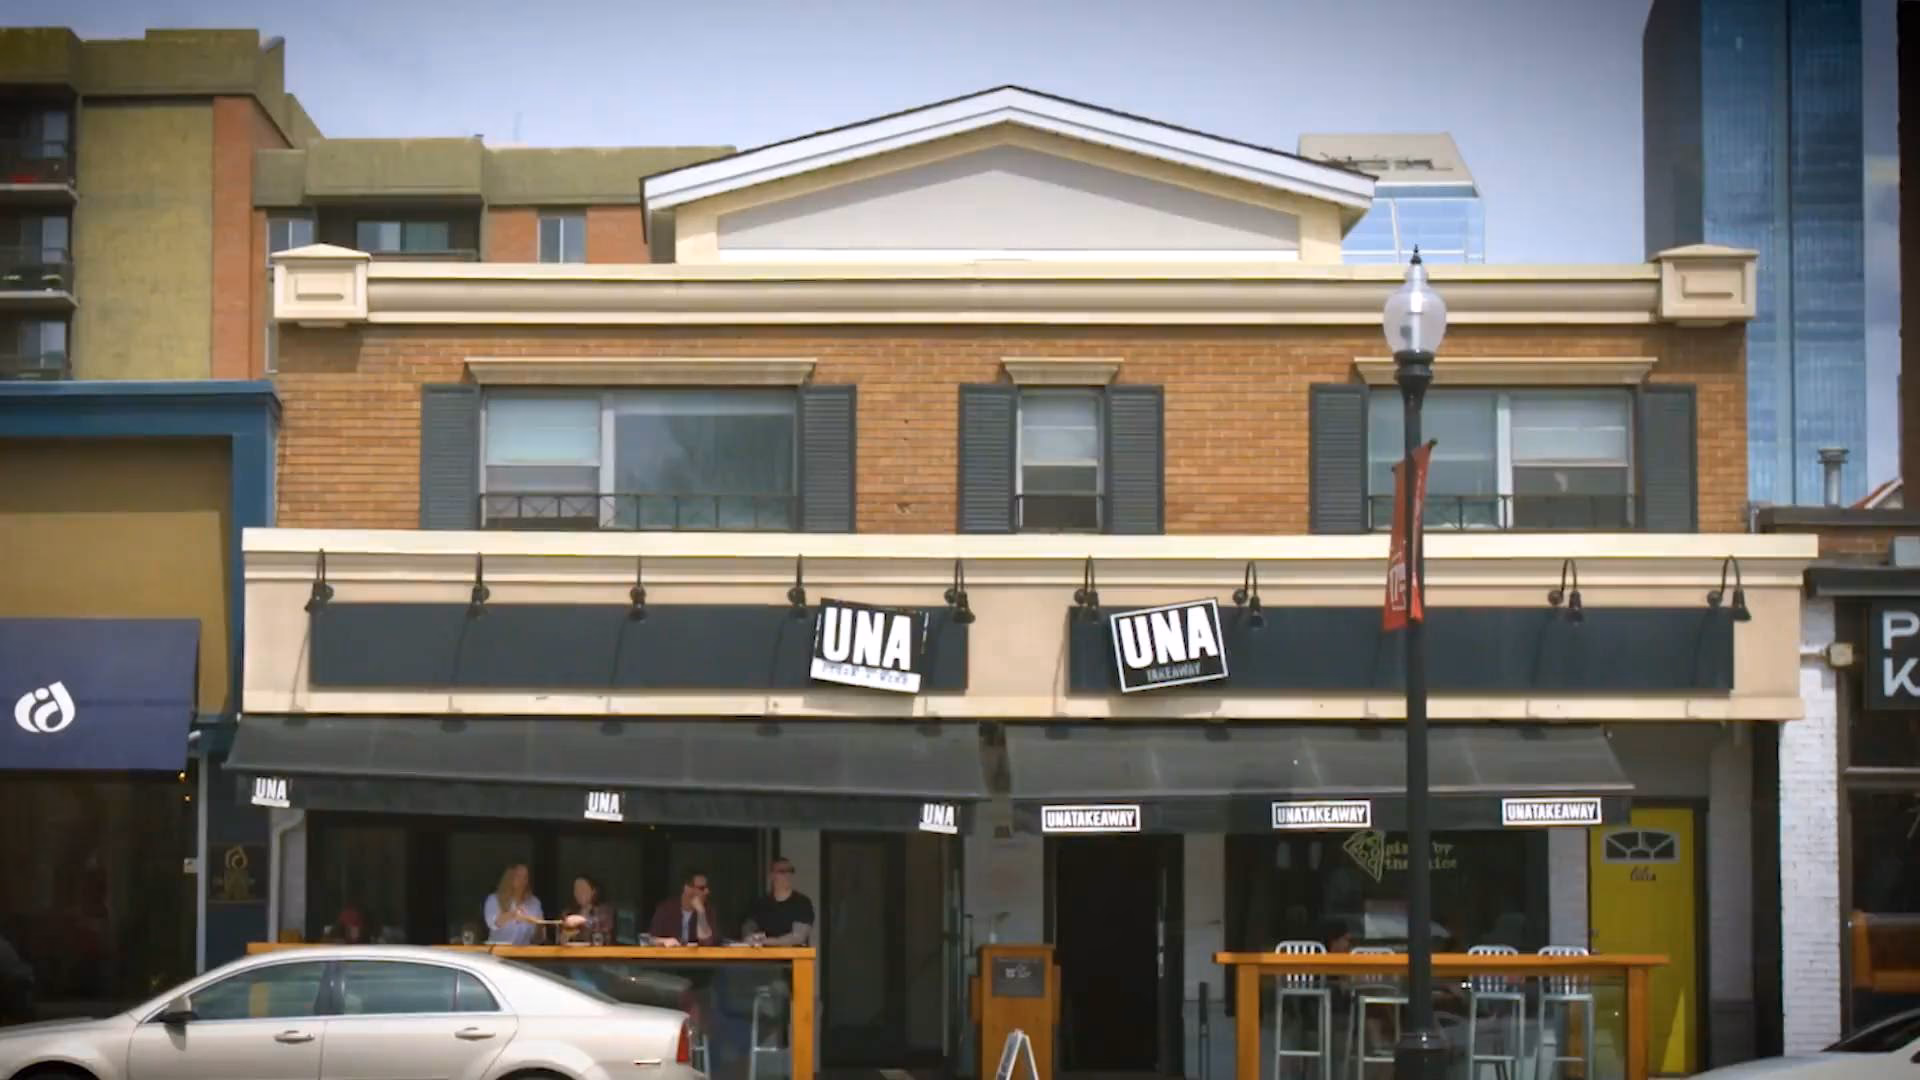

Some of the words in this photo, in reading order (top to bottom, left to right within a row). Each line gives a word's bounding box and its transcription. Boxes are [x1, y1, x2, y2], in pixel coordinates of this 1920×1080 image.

[822, 606, 911, 671] UNA
[1119, 605, 1218, 669] UNA
[1146, 661, 1201, 682] TAKEAWAY
[255, 777, 287, 801] UNA
[588, 791, 619, 814] UNA
[1507, 803, 1595, 820] UNATAKEAWAY
[923, 803, 955, 826] UNA
[1046, 810, 1135, 827] UNATAKEAWAY
[1277, 806, 1366, 823] UNATAKEAWAY
